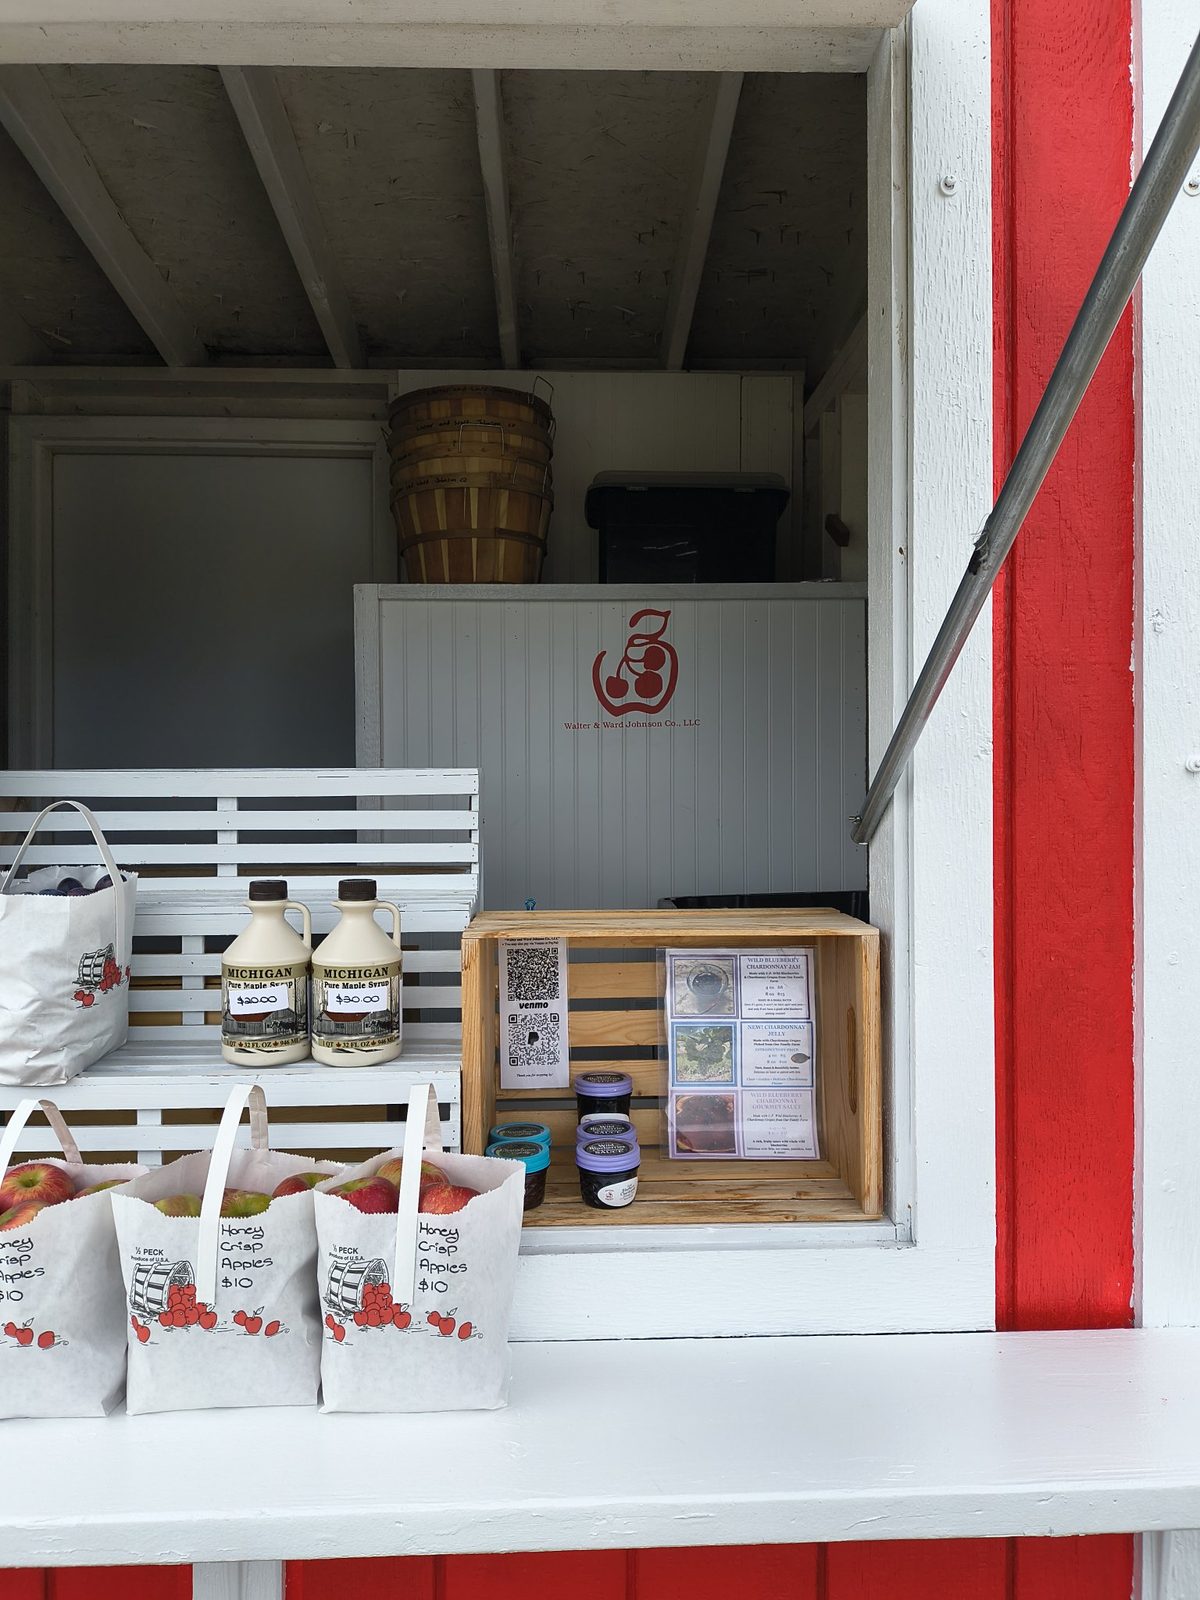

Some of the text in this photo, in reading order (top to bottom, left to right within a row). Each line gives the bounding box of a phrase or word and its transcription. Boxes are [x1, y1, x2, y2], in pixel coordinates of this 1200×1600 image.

[564, 722, 591, 730] Walter
[603, 720, 624, 729] Ward
[626, 720, 662, 728] Johnson
[227, 967, 293, 979] MICHIGAN
[323, 967, 389, 979] MICHIGAN
[243, 981, 268, 990] Maple
[269, 980, 294, 988] Syp
[324, 981, 340, 989] Pure
[341, 982, 366, 990] Maple
[335, 993, 380, 1005] $30.00
[519, 1001, 549, 1010] venmo
[221, 1224, 265, 1240] Honey
[419, 1221, 460, 1244] Honey
[0, 1237, 34, 1252] oney
[220, 1241, 264, 1253] Crisp
[338, 1246, 359, 1255] PECK
[418, 1240, 458, 1257] Crisp
[143, 1248, 164, 1256] PECK
[0, 1254, 31, 1266] risp
[221, 1257, 274, 1271] Apples
[419, 1258, 468, 1274] Apples
[221, 1276, 254, 1288] $10
[418, 1278, 449, 1293] $10
